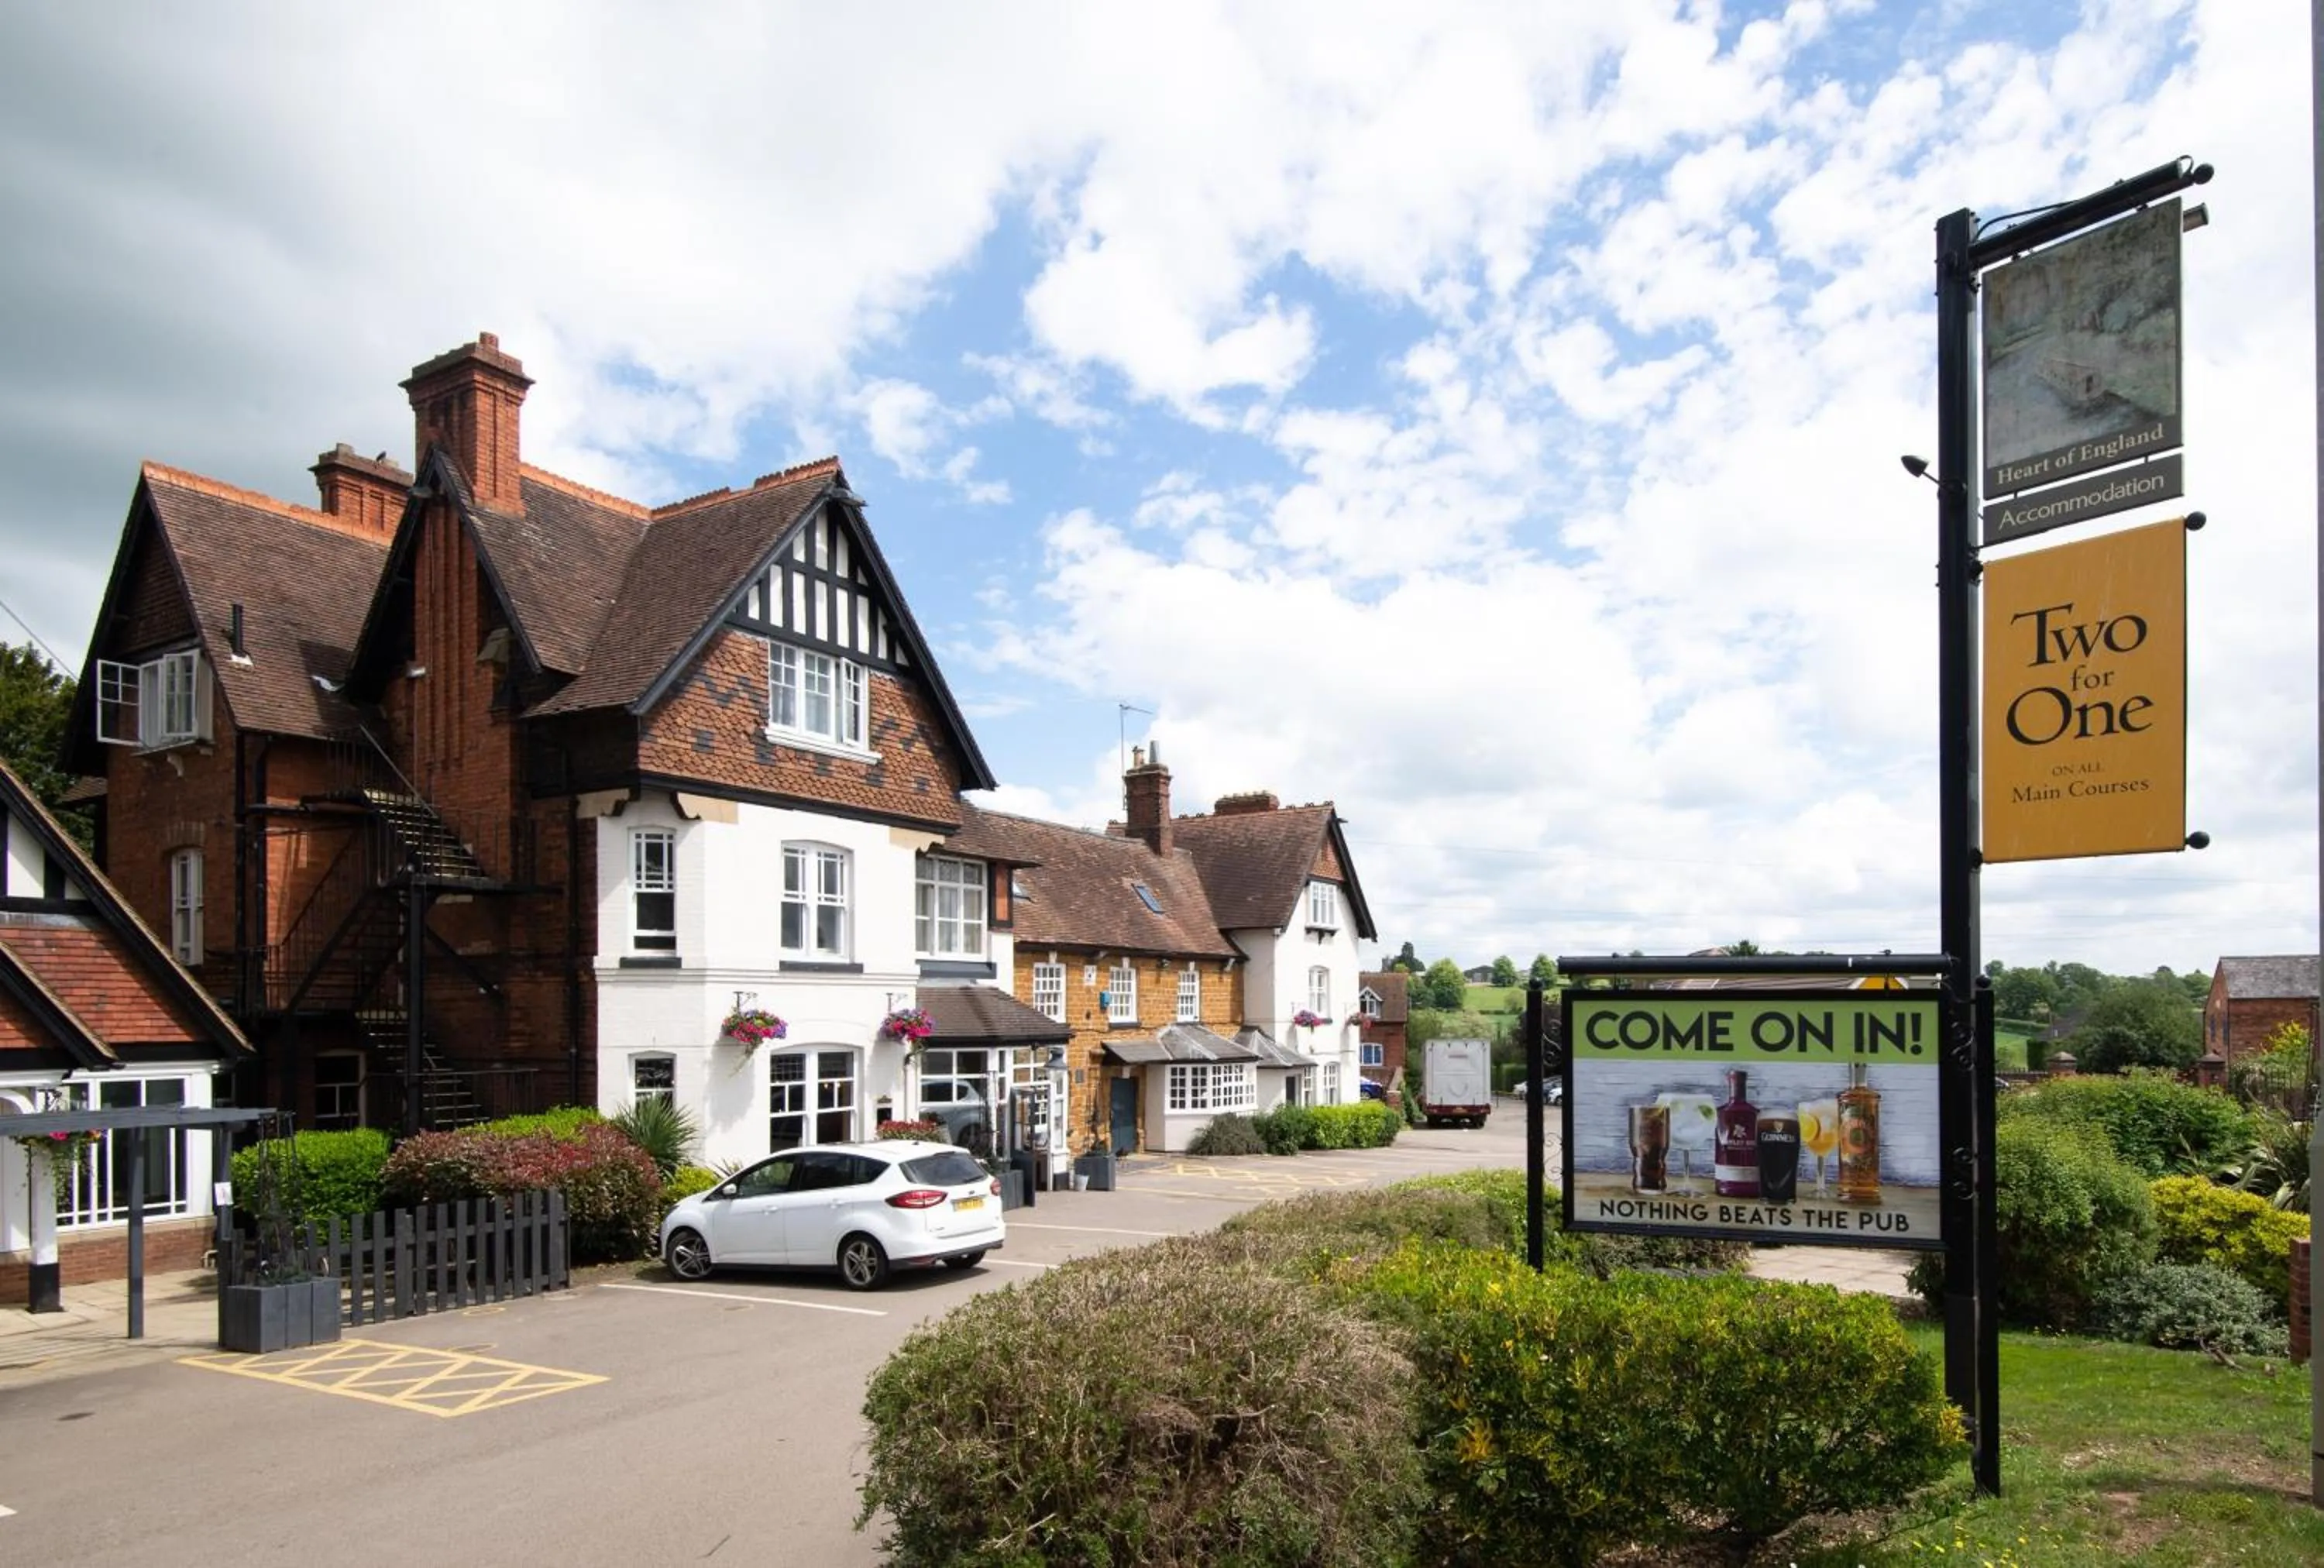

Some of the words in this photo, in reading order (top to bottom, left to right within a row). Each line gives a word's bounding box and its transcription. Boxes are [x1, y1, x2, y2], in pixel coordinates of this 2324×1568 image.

[1997, 456, 2049, 485] Heart
[2054, 448, 2077, 469] of
[2080, 423, 2164, 462] England
[1999, 474, 2164, 531] Accommodation
[2010, 602, 2147, 668] Two
[2070, 665, 2115, 692] for
[2006, 686, 2154, 745] One
[2012, 784, 2060, 803] Main
[2068, 779, 2150, 798] Courses
[2051, 765, 2074, 776] ON
[2079, 762, 2104, 774] ALL
[1586, 1010, 1734, 1051] COME
[1751, 1011, 1834, 1053] ON
[1854, 1012, 1923, 1055] IN!
[1600, 1199, 1709, 1222] NOTHING
[1719, 1205, 1792, 1226] BEATS
[1802, 1209, 1848, 1229] THE
[1859, 1212, 1910, 1233] PUB
